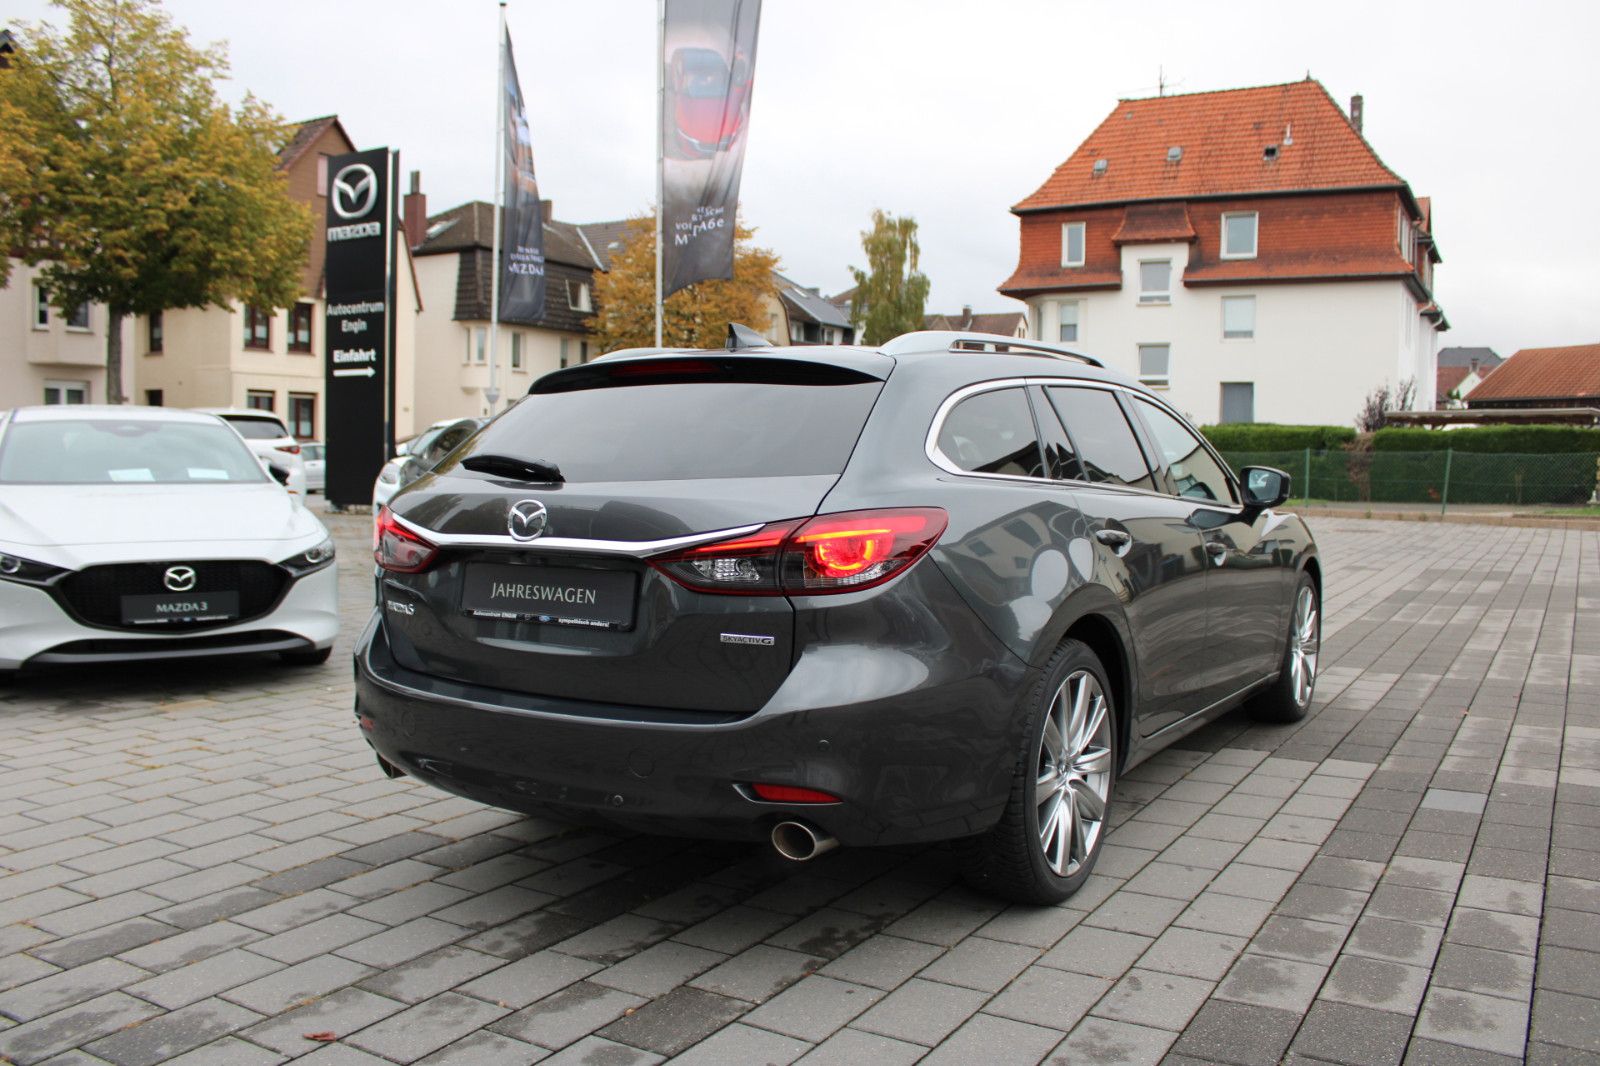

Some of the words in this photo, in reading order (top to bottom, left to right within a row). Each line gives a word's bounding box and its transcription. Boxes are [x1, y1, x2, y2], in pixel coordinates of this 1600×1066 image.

[326, 301, 385, 316] Autocentrum
[341, 318, 368, 334] Engin
[333, 348, 376, 363] Einfahrt
[491, 582, 596, 605] JAHRESWAGEN
[156, 603, 199, 613] MAZDA
